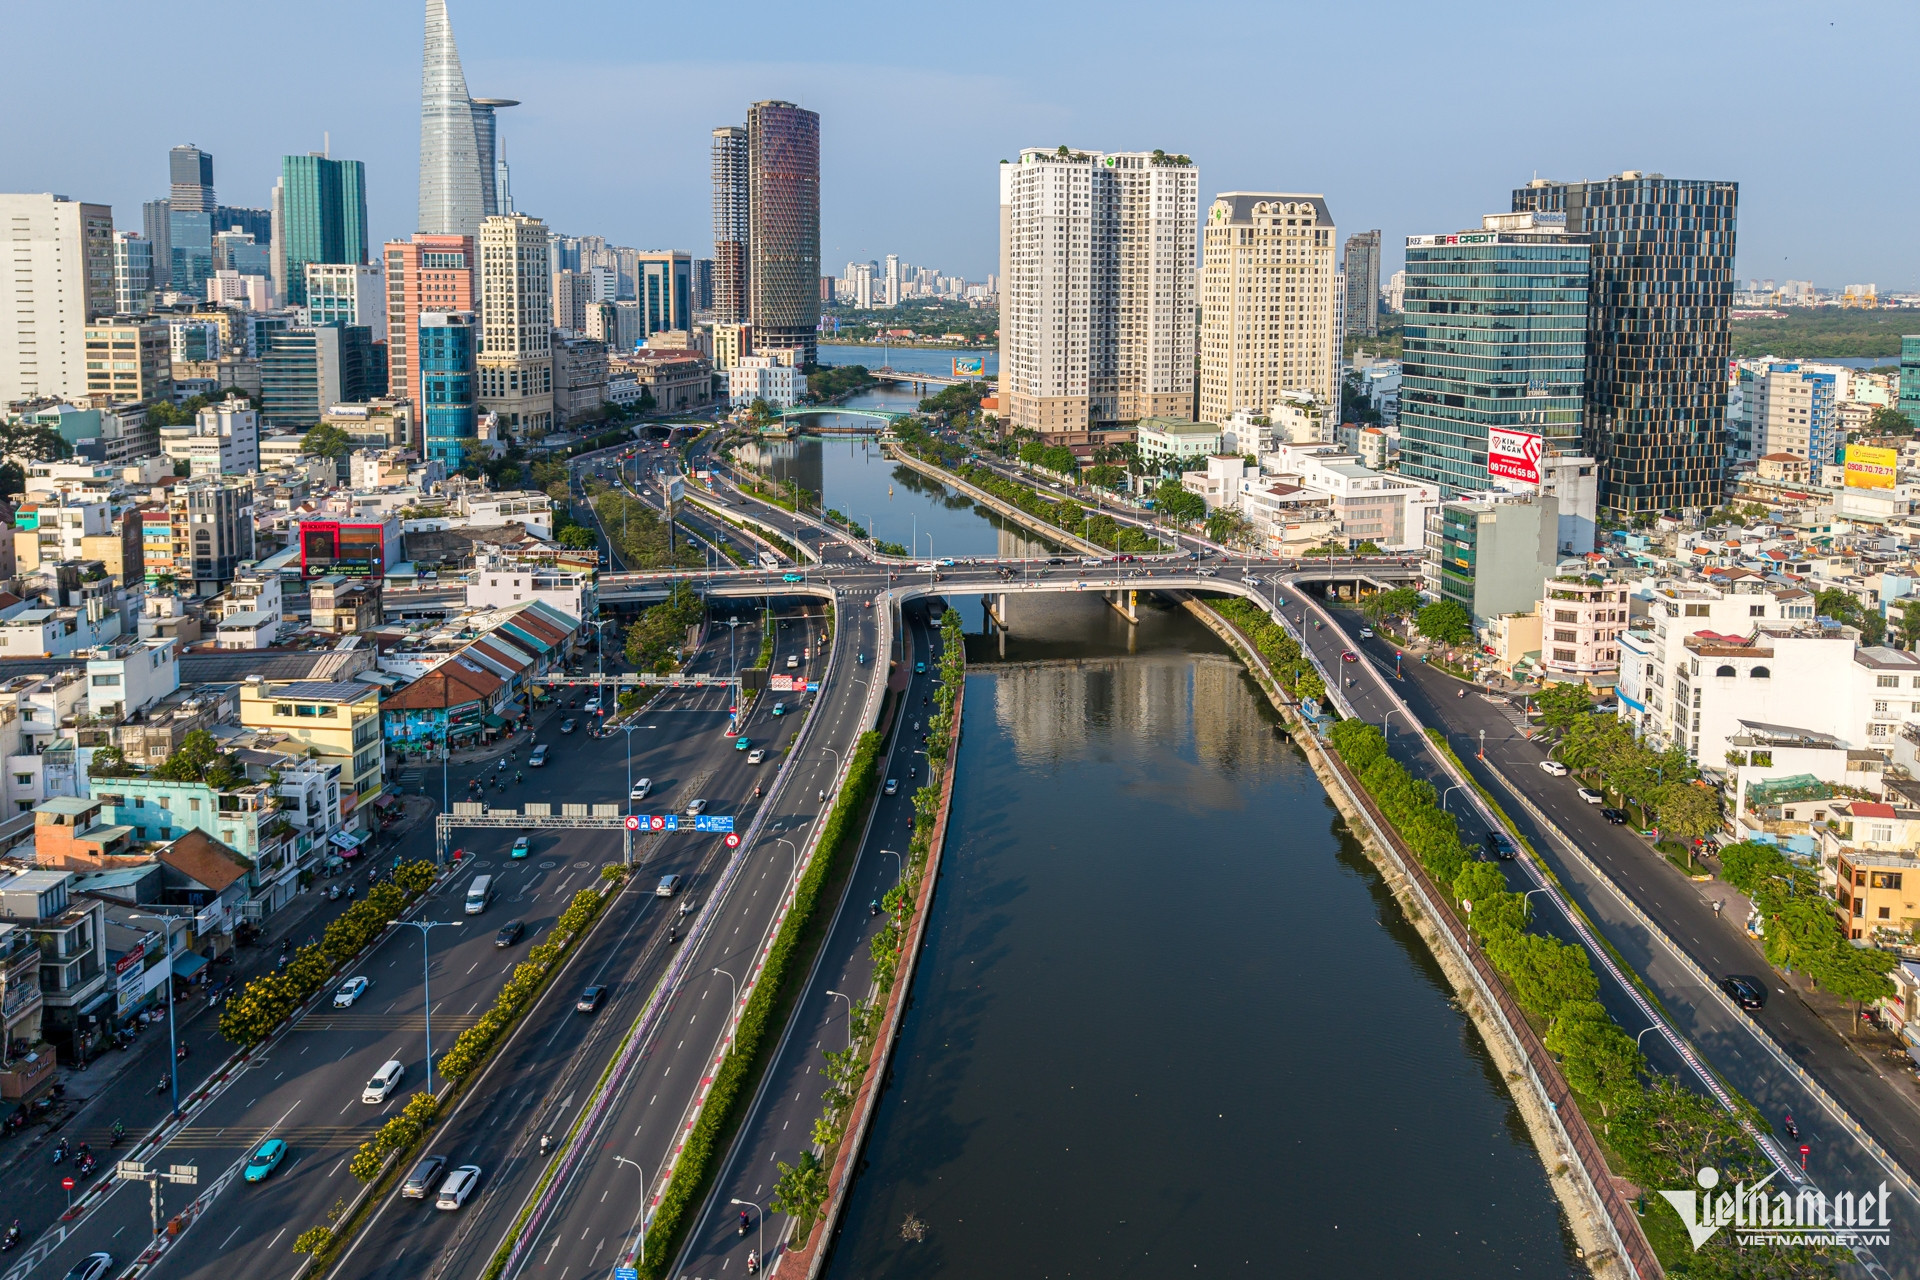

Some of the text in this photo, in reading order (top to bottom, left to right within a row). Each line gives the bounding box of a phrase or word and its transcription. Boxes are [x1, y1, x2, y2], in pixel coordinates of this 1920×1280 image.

[1533, 212, 1566, 222] Reetech
[1446, 235, 1458, 244] FE
[1459, 234, 1496, 244] CREDIT
